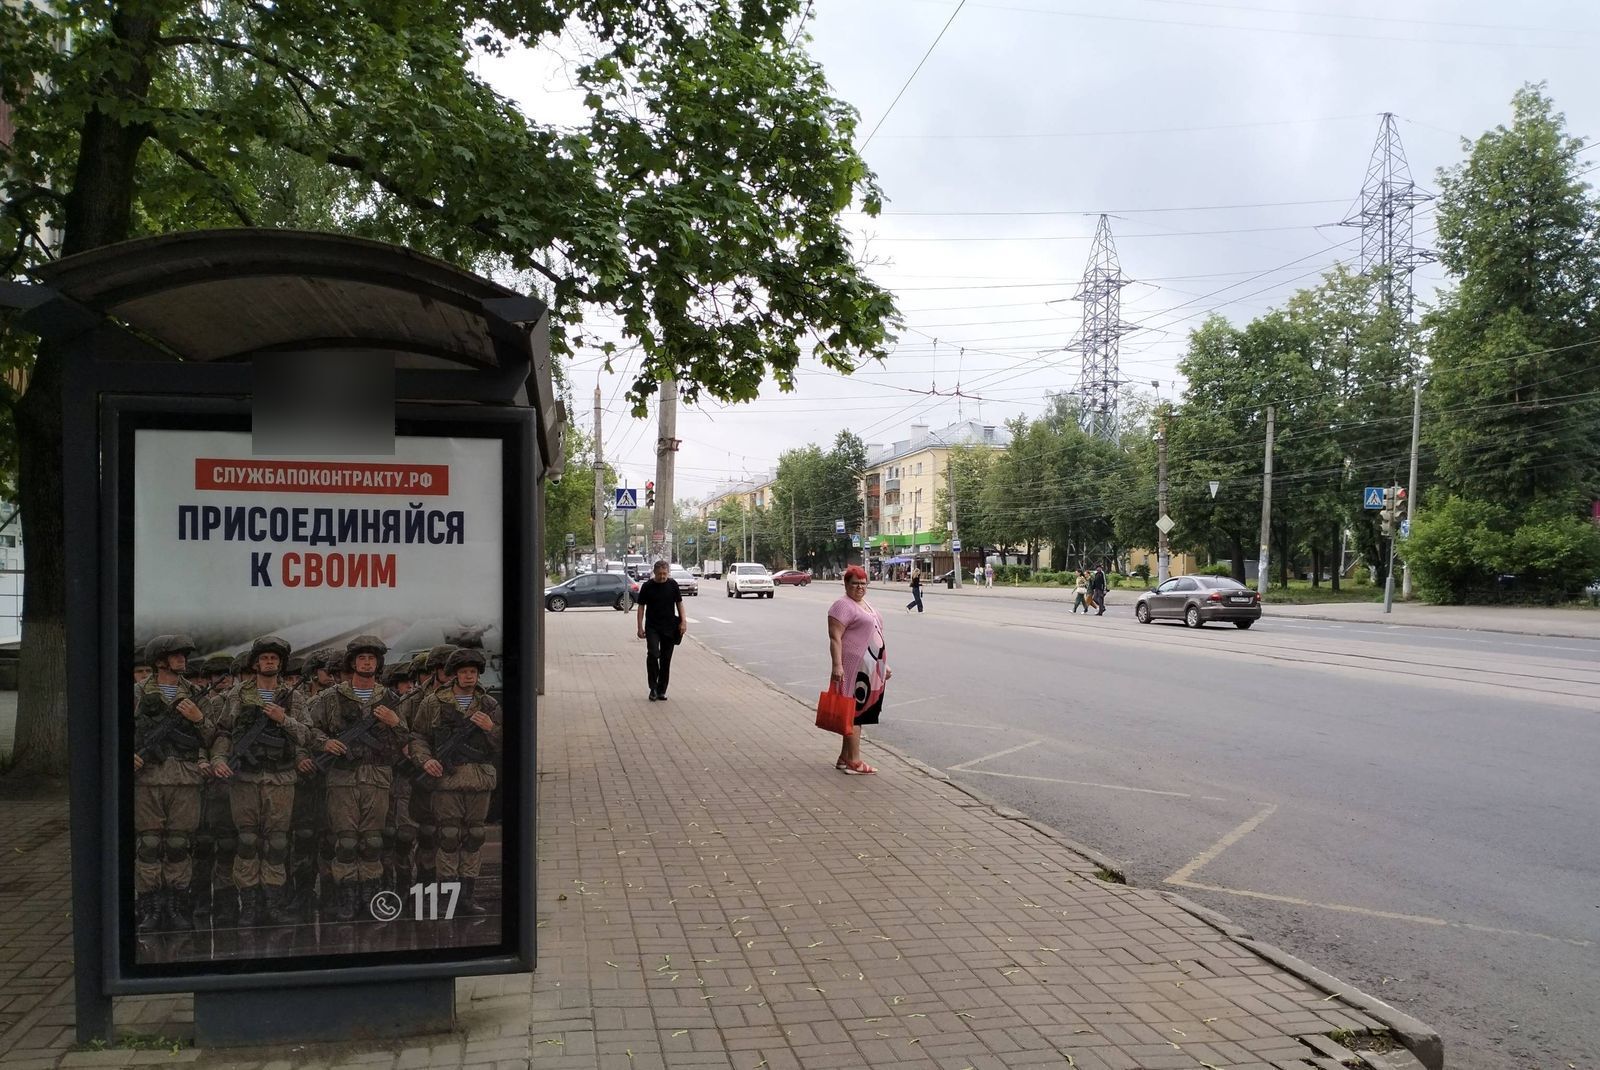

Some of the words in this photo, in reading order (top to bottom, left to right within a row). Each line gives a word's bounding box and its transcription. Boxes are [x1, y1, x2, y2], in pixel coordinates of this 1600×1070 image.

[213, 466, 433, 488] СЛУЖБАПОКОНТРАКТУ.РФ
[178, 502, 464, 546] ПРИСОЕДИНЯЙСЯ
[251, 552, 272, 587] К
[282, 552, 396, 588] СВОИМ
[409, 882, 461, 920] 117
